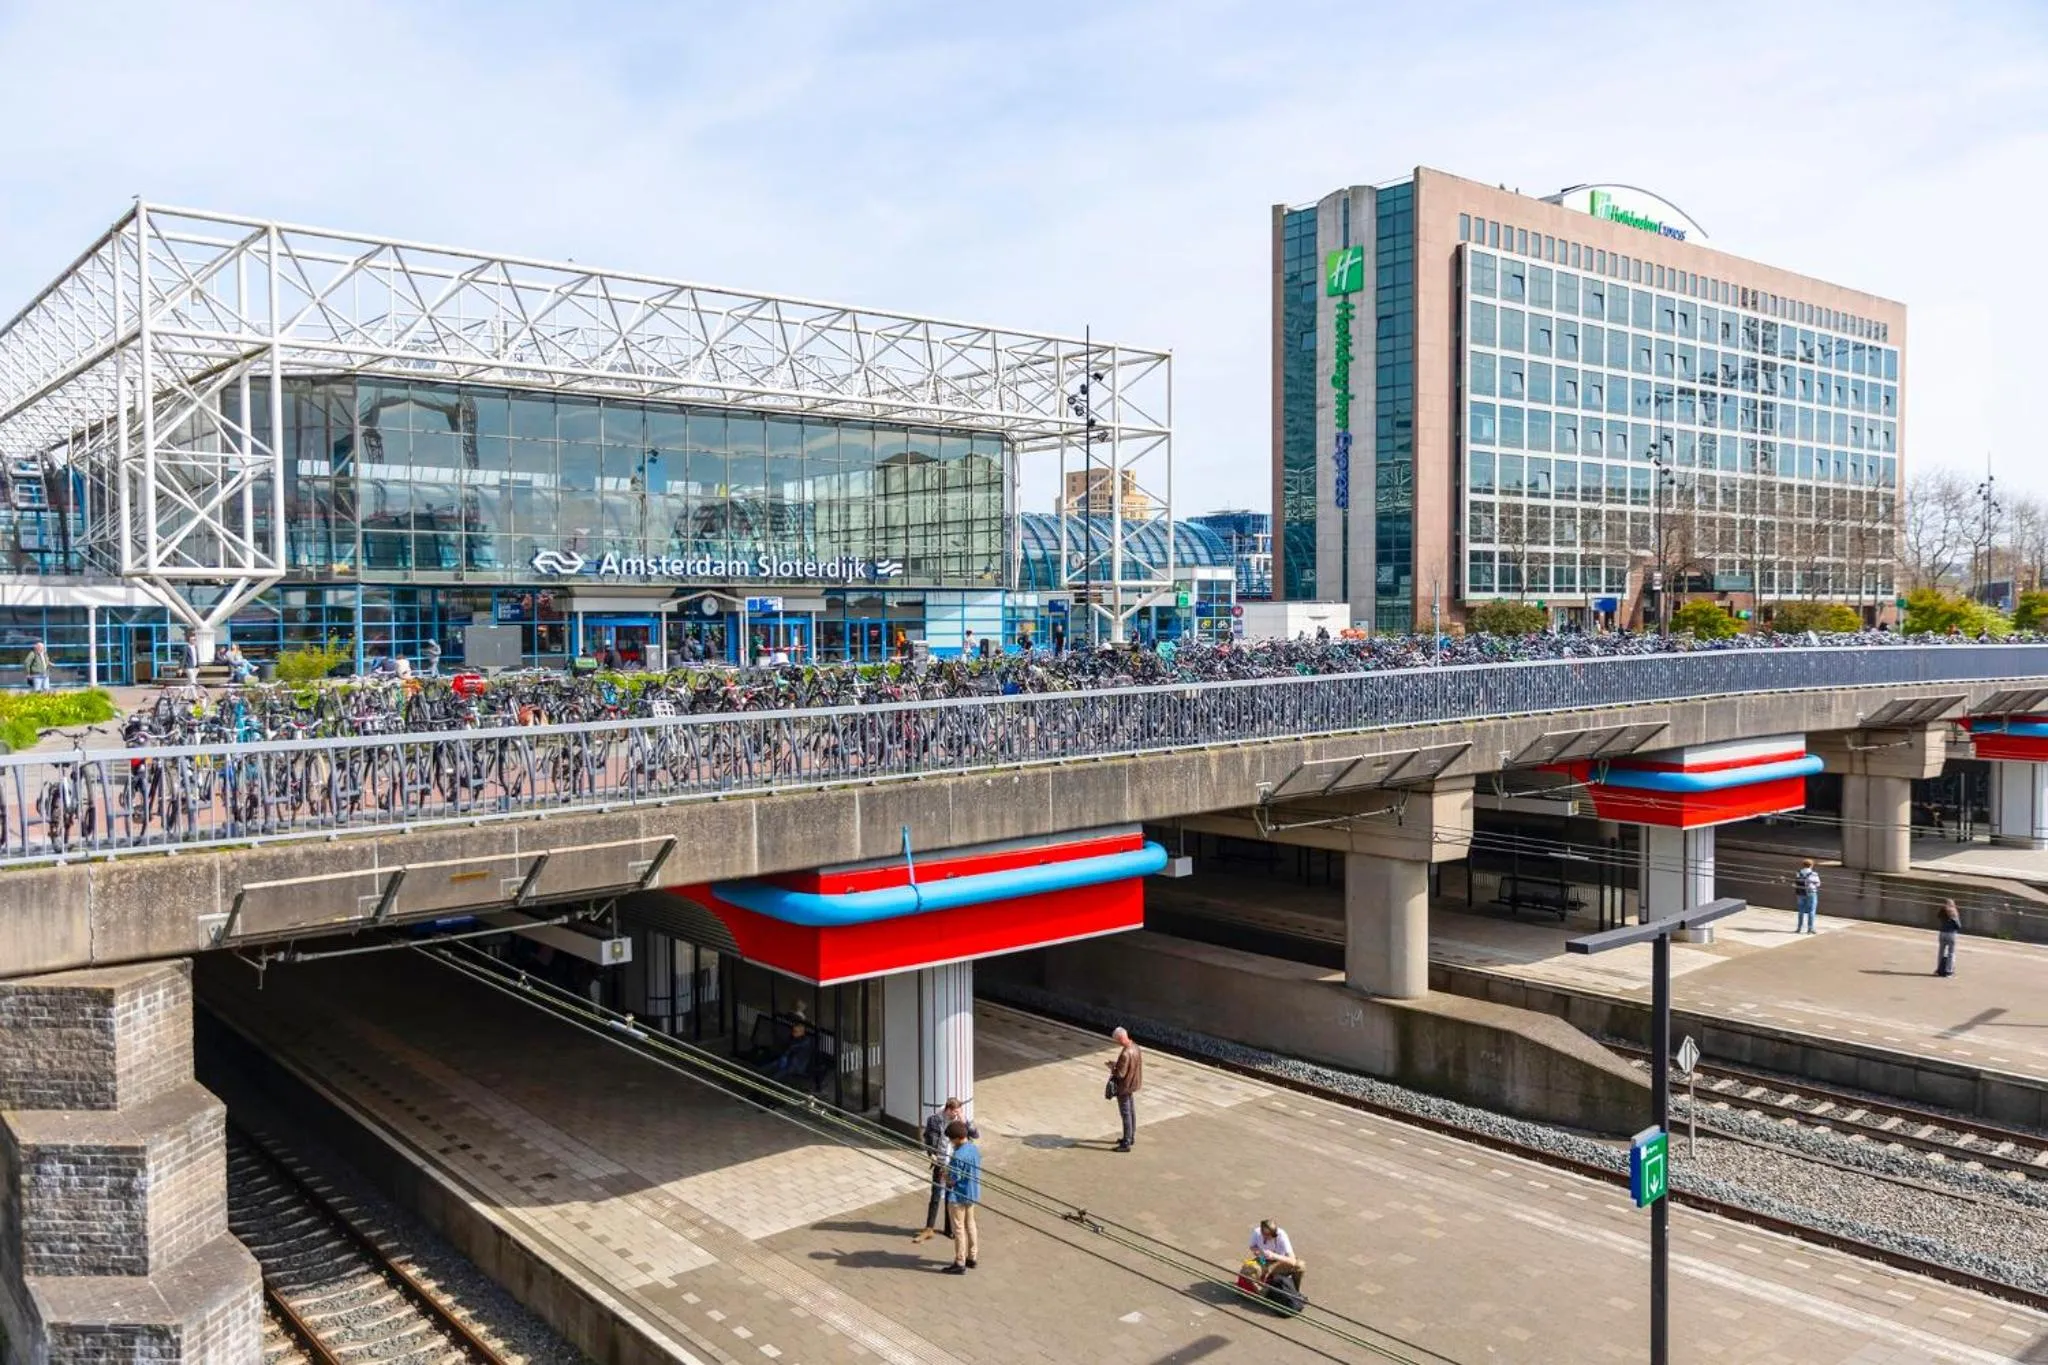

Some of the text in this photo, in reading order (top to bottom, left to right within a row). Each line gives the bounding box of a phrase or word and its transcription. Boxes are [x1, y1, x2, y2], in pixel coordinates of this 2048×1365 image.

[1331, 302, 1356, 509] Holiday Inn Express
[599, 551, 867, 583] Amsterdam Sloterdijk
